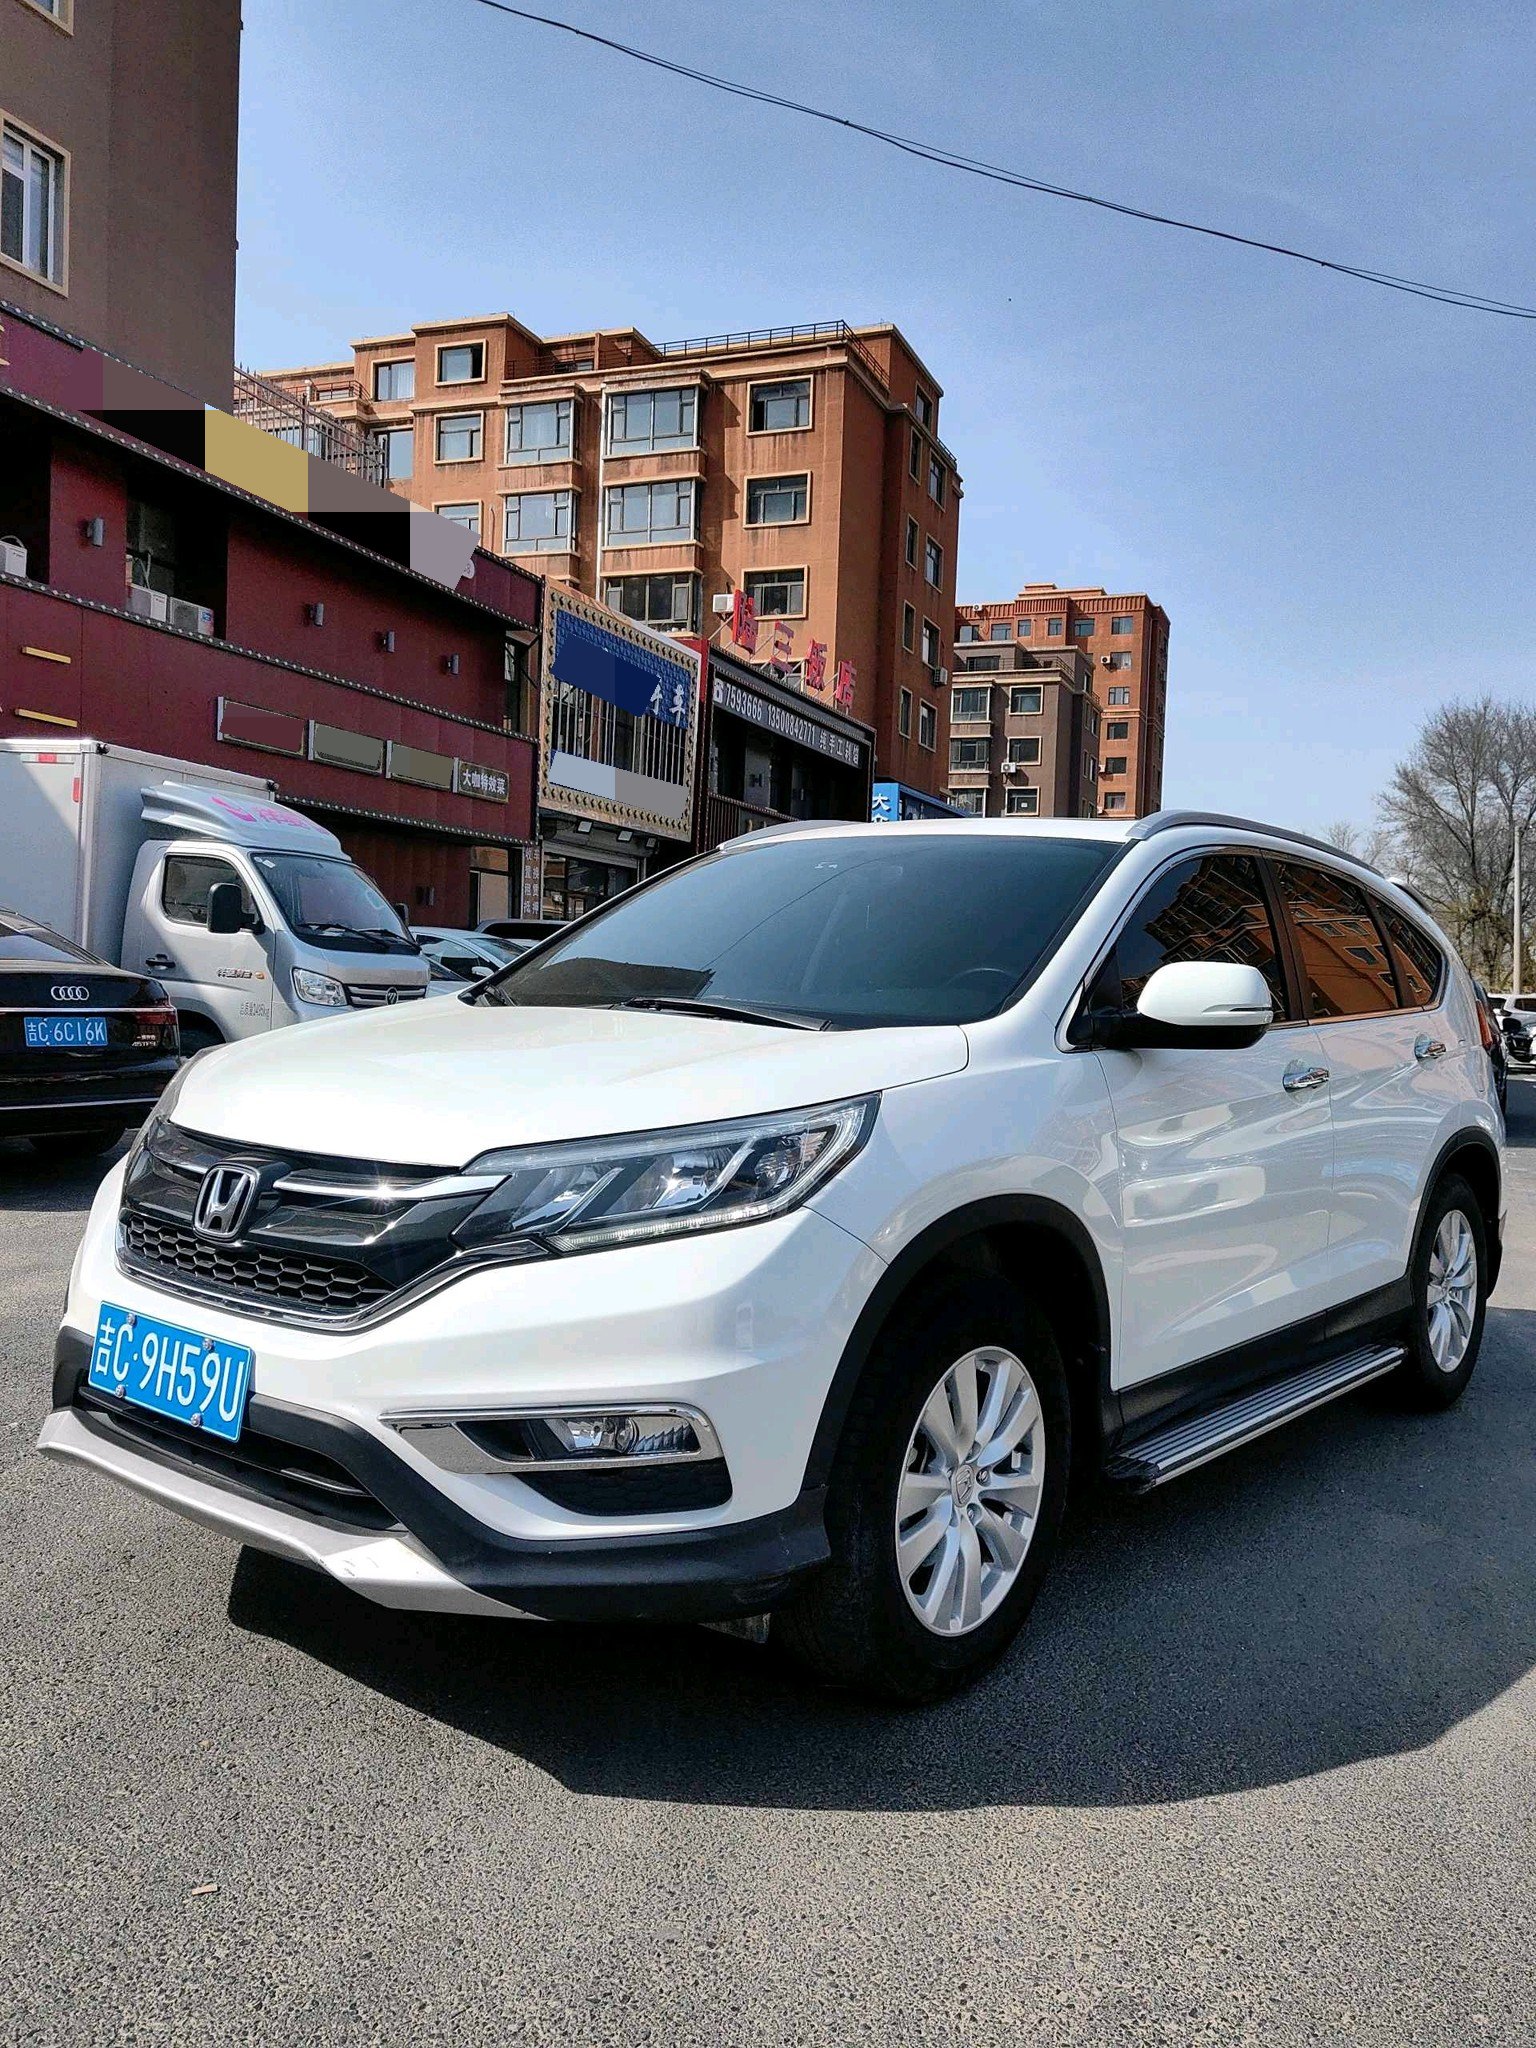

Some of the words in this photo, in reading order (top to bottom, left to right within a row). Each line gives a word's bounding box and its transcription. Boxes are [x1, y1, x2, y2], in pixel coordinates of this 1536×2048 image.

[726, 683, 762, 721] 7593666
[767, 704, 816, 745] 13500842771
[463, 769, 505, 795] 大咖特效菜
